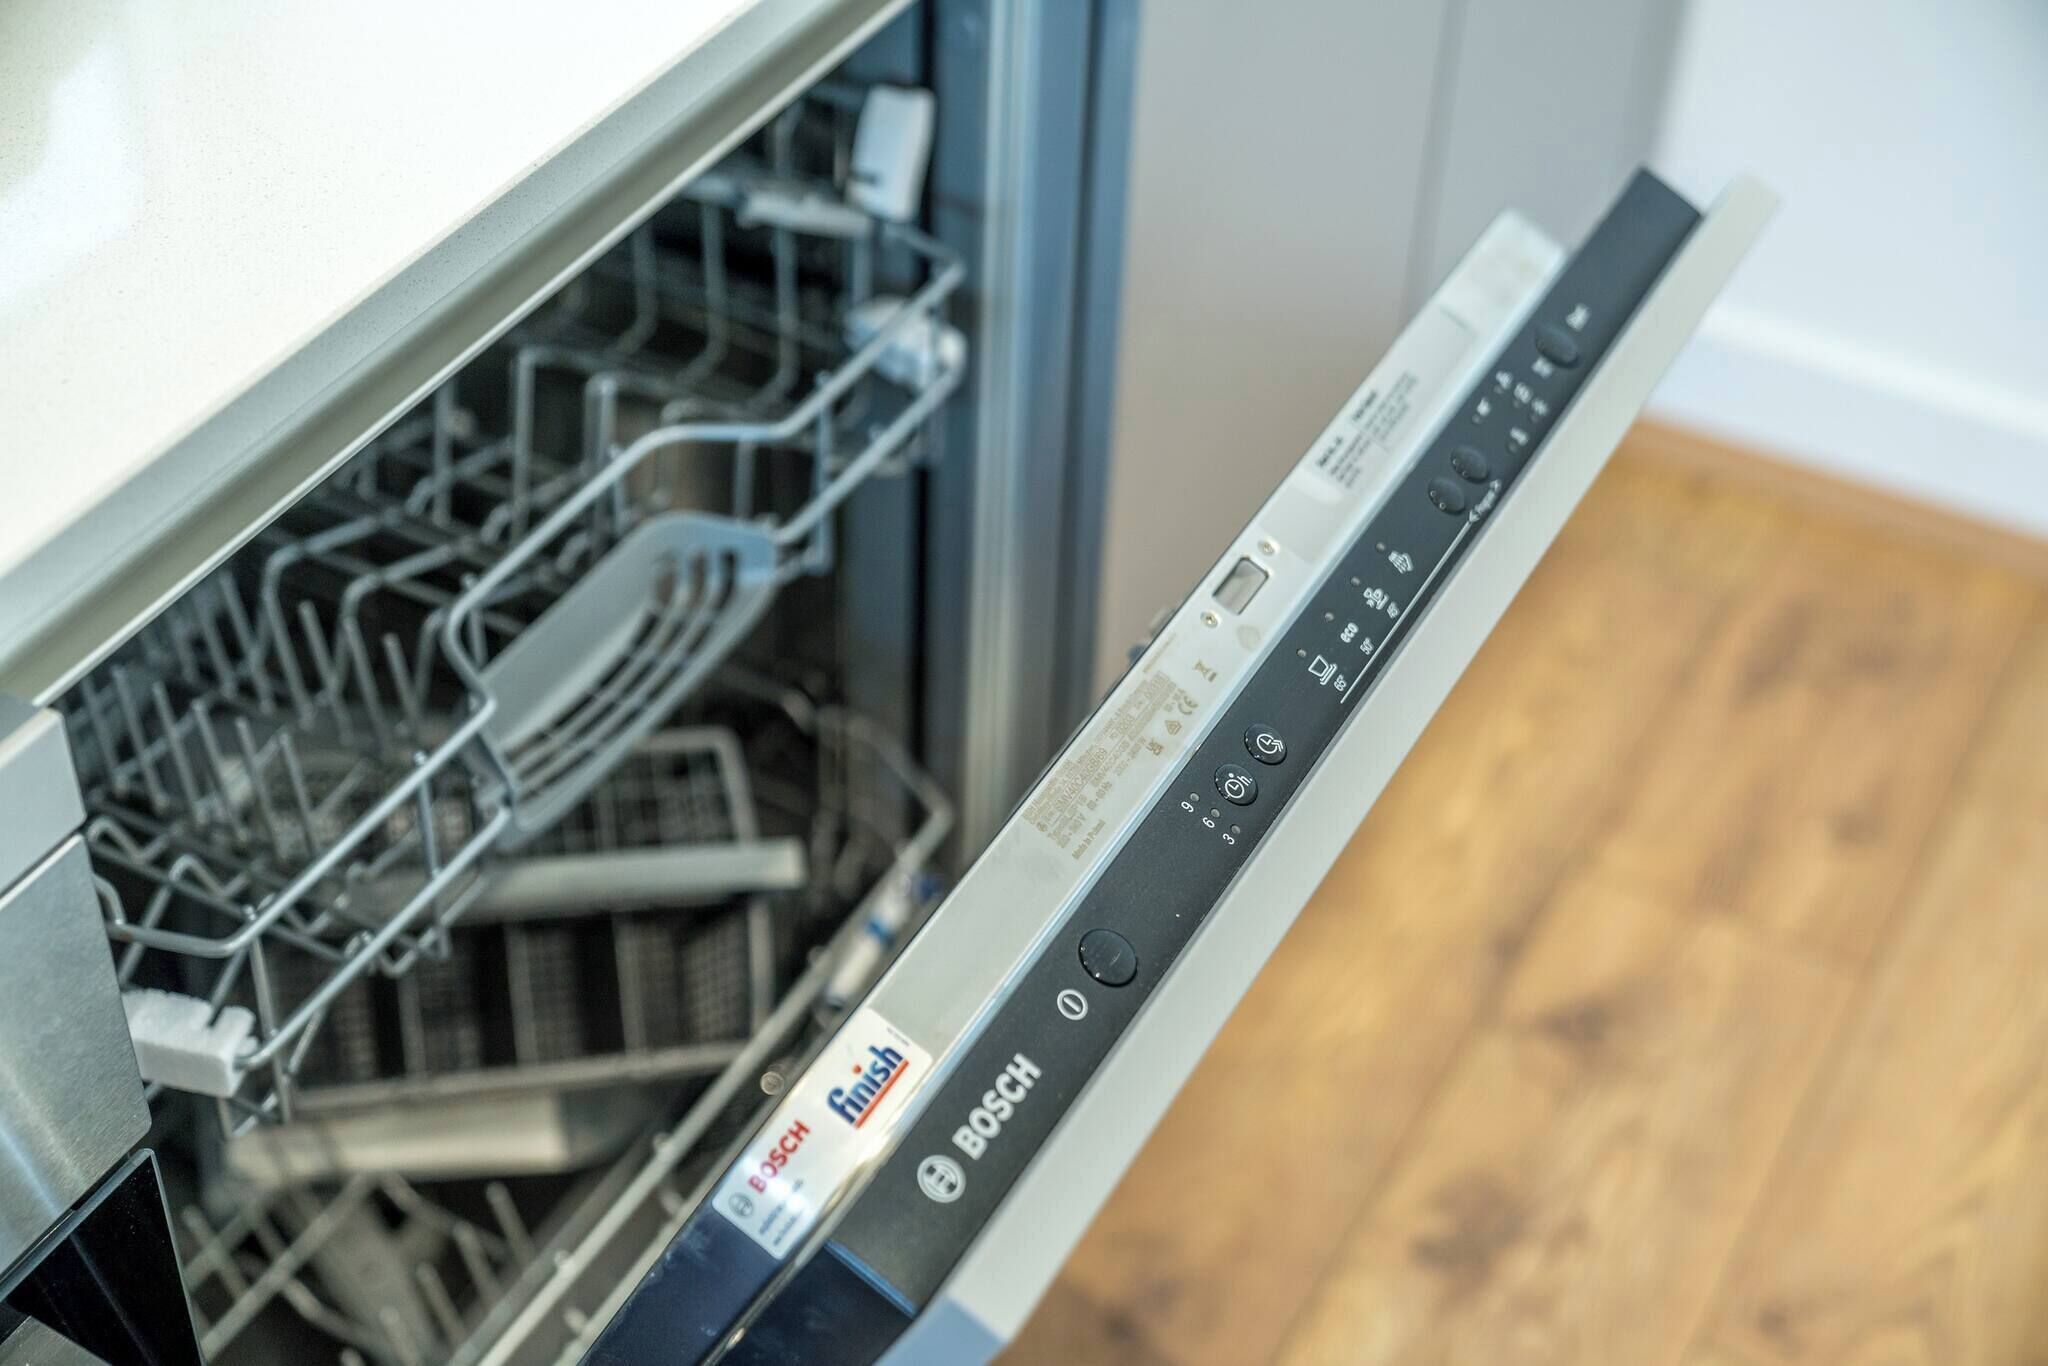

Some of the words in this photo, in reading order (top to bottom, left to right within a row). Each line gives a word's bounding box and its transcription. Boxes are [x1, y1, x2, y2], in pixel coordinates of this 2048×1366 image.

[1340, 622, 1358, 643] eco
[1181, 801, 1194, 813] 9
[1202, 817, 1215, 829] 6
[1222, 833, 1235, 845] 3
[827, 1043, 908, 1126] finish
[951, 1053, 1042, 1161] BOSCH
[747, 1119, 811, 1194] BOSCH
